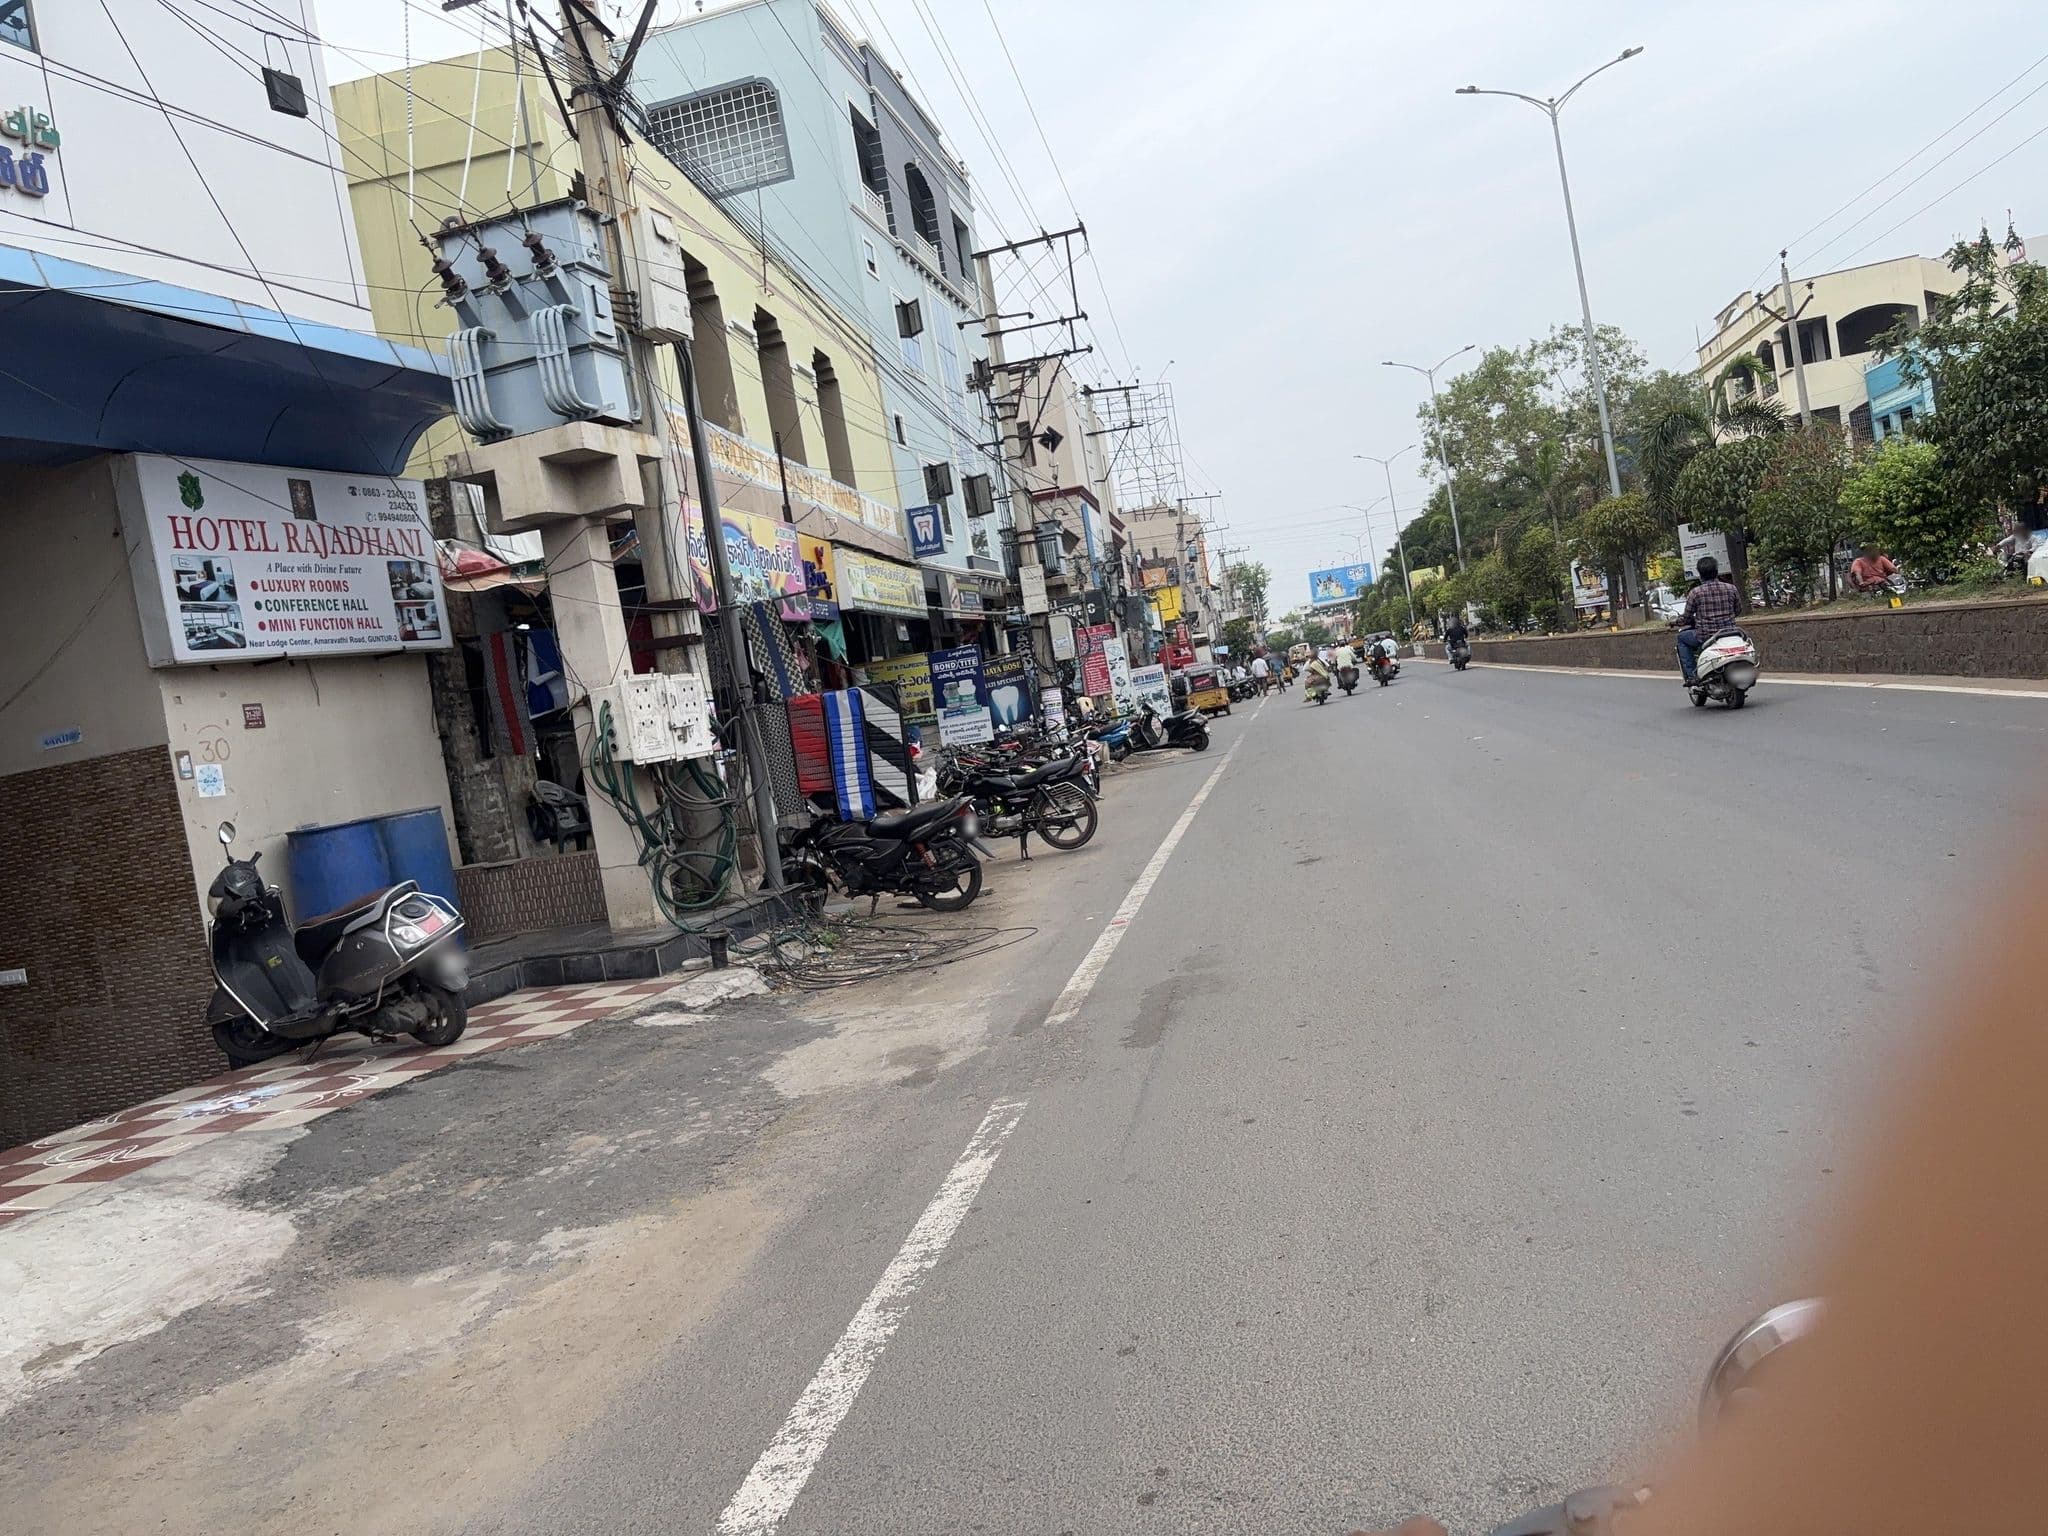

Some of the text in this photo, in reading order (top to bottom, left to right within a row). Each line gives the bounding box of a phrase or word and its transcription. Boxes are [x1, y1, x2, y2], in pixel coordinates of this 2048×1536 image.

[167, 515, 426, 560] HOTEL RAJADHANI
[266, 562, 363, 575] A Place with Divine Future
[260, 579, 350, 593] LUXURY ROOMS
[265, 598, 369, 612] CONFERENCE HALL
[268, 616, 384, 633] MINI FUNCTION HALL
[249, 639, 266, 649] Near
[267, 639, 289, 650] Lodge
[289, 637, 313, 647] Center,
[314, 635, 350, 646] Amaravathi
[349, 635, 367, 644] Road,
[934, 661, 957, 672] BOND
[959, 657, 977, 668] TITE
[1002, 660, 1021, 672] BOSE
[198, 737, 231, 763] 30
